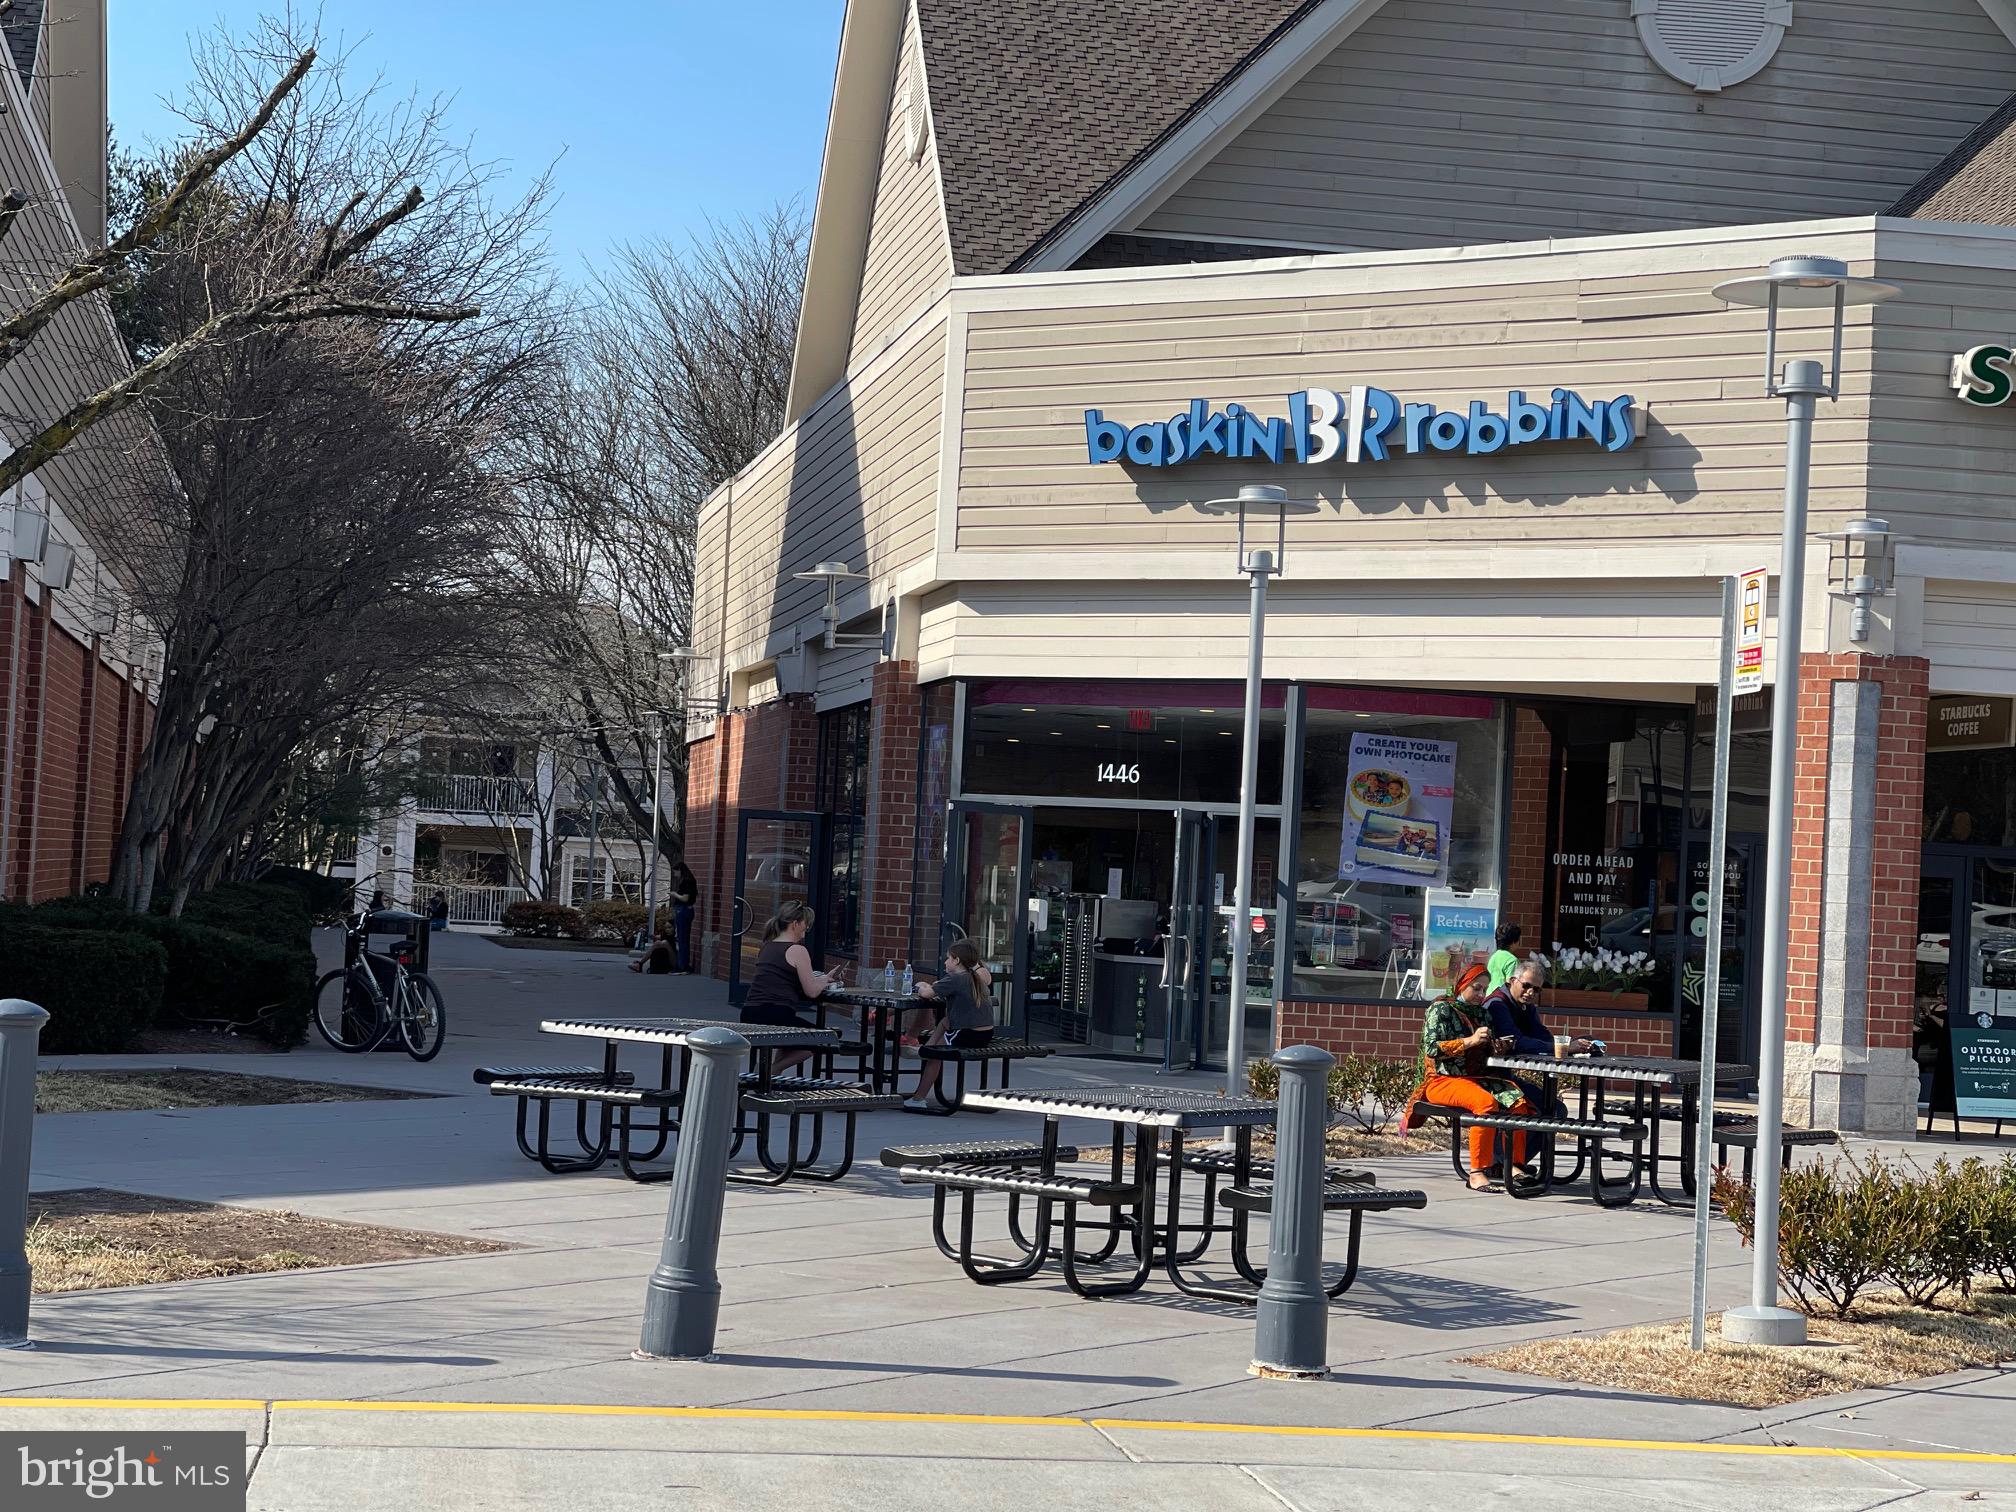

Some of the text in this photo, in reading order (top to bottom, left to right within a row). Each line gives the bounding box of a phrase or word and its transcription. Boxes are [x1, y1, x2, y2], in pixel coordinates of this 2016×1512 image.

[1288, 385, 1400, 464] BR
[1940, 703, 1991, 720] STARBUCKS
[1947, 721, 1980, 737] COFFEE
[1367, 738, 1440, 753] CREATE YOUR
[1354, 746, 1451, 763] OWN PHOTOCAKE
[1097, 763, 1140, 784] 1446
[1553, 853, 1634, 868] ORDER AHEAD
[1568, 872, 1617, 886] AND PAY
[1692, 870, 1705, 878] TO
[1724, 872, 1741, 880] YOU
[1573, 893, 1611, 903] WITH THE
[1559, 905, 1624, 916] STARBUCKS APP
[1436, 913, 1488, 930] Refresh
[1961, 1046, 2016, 1057] OUTDOOR
[1969, 1055, 2011, 1064] PICKUP
